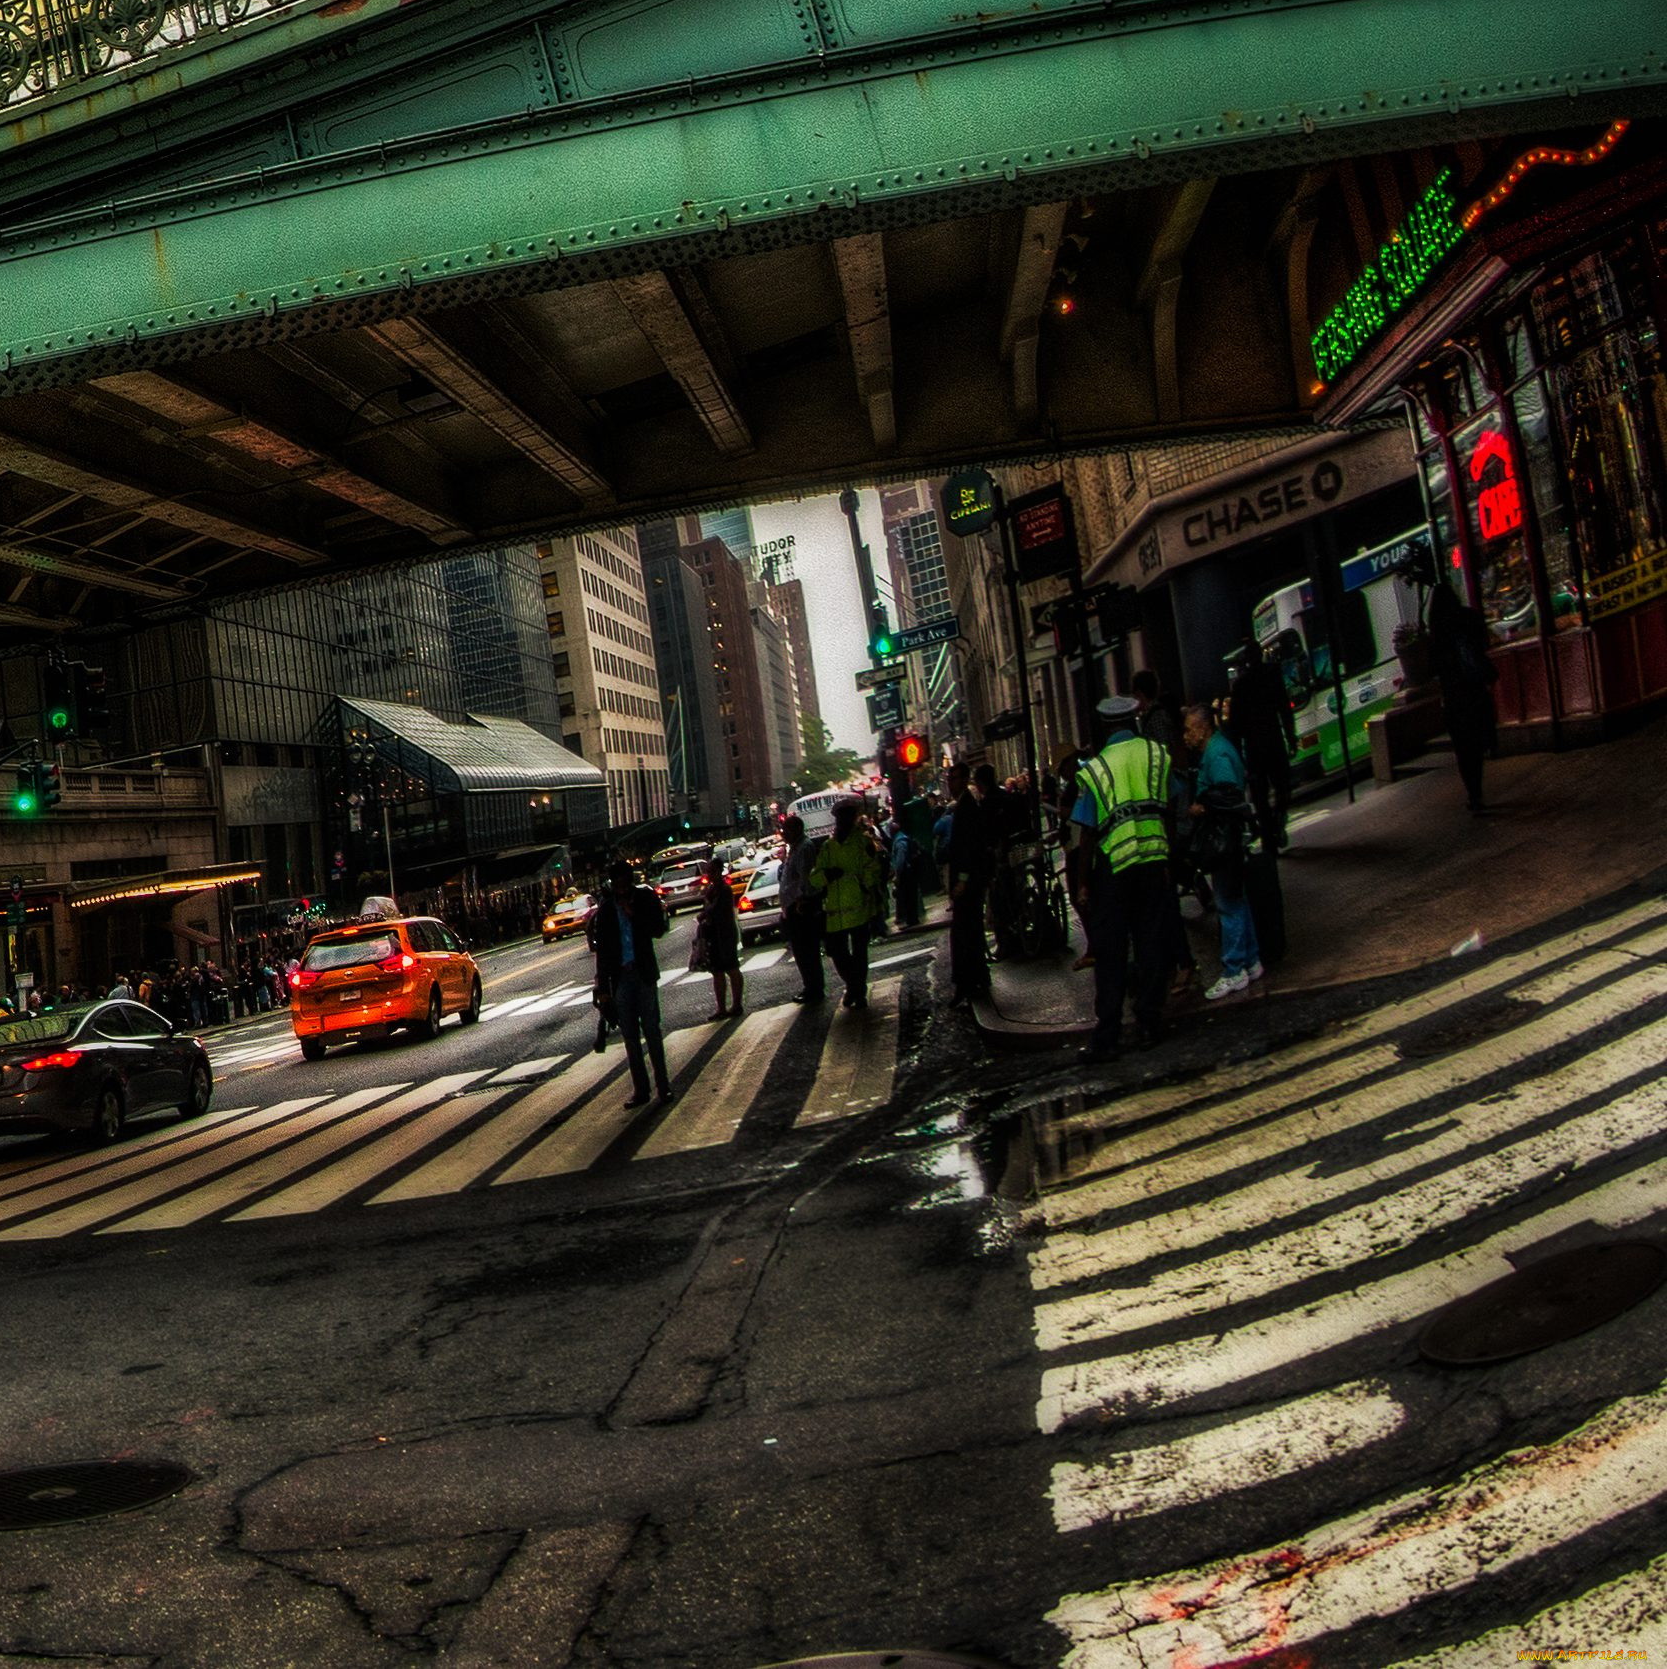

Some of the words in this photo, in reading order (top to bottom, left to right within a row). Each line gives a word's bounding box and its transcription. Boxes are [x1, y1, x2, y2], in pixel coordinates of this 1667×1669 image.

[1182, 476, 1307, 548] CHASE
[751, 535, 796, 557] TUDOR
[901, 633, 925, 648] Park
[927, 628, 947, 641] Ave
